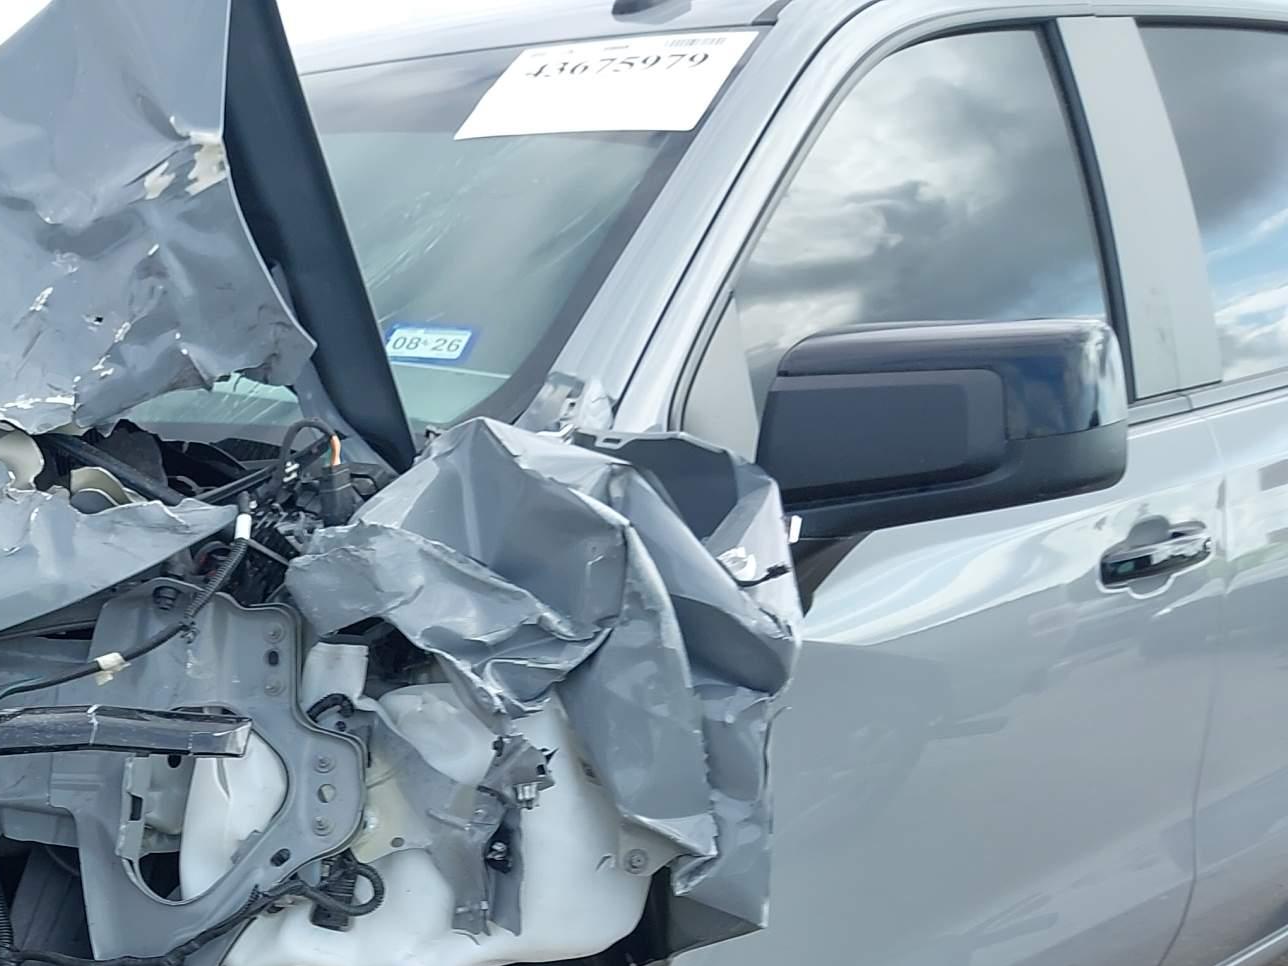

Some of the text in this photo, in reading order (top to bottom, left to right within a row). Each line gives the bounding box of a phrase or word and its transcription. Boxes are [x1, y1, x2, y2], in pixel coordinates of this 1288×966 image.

[525, 52, 710, 78] 43675979
[392, 336, 463, 352] 08 26
